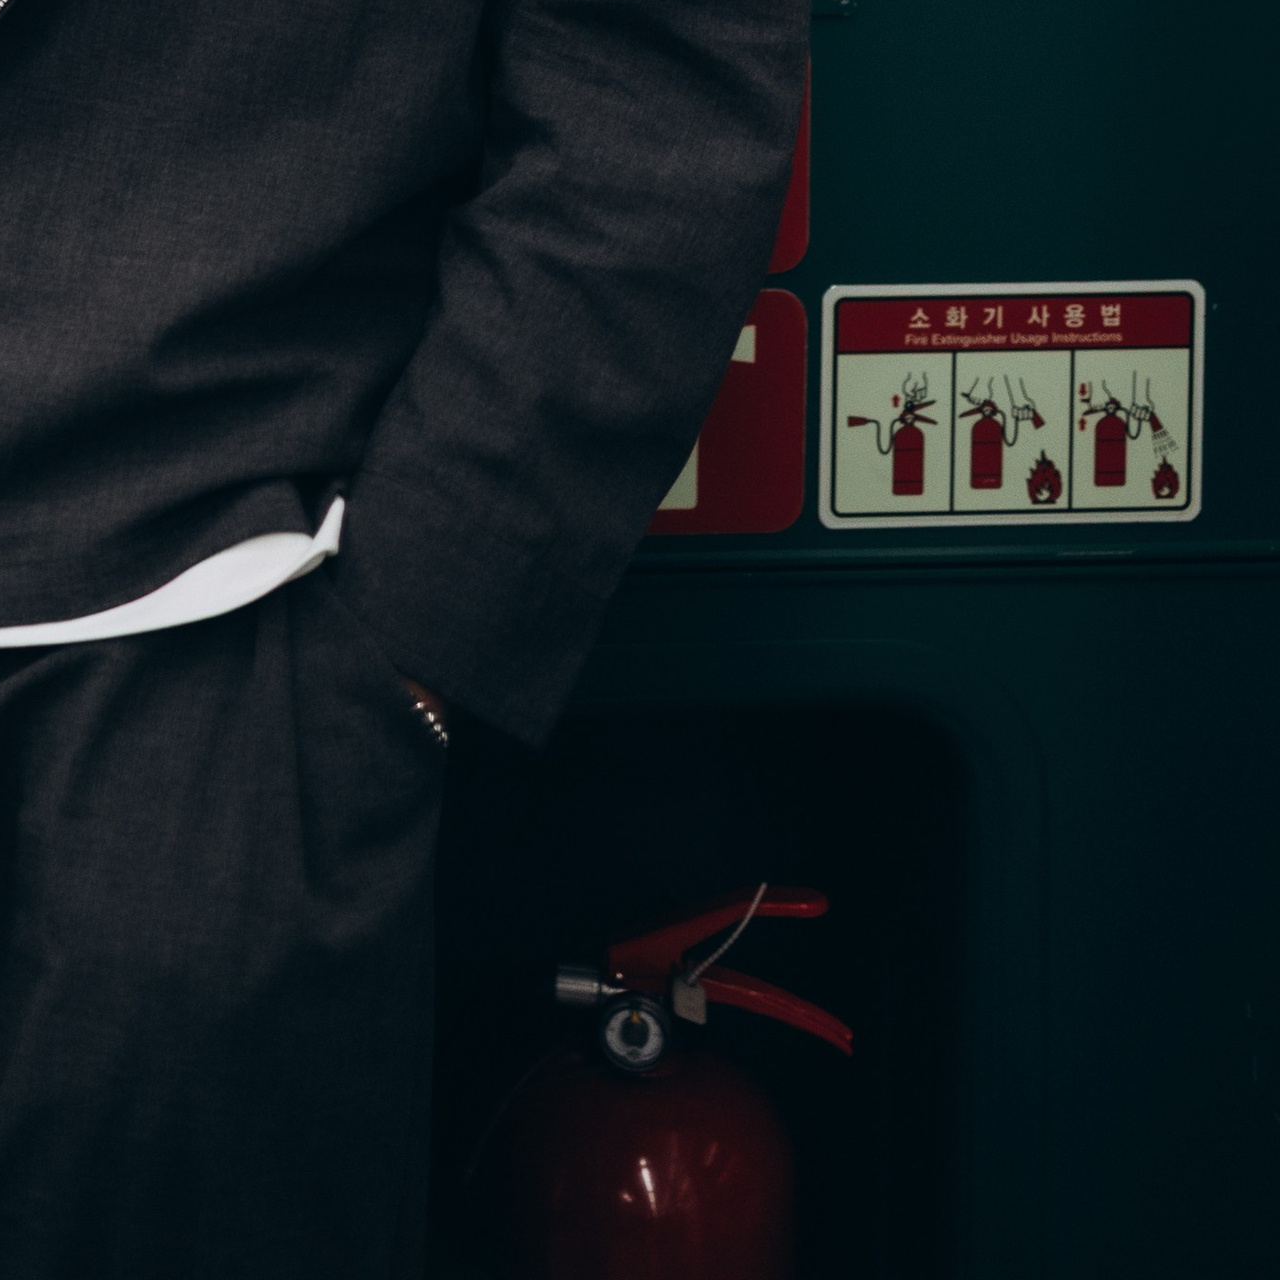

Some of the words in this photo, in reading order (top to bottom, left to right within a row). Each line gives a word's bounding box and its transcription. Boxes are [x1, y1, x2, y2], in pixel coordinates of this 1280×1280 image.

[907, 305, 1005, 330] 소화기
[1026, 303, 1122, 329] 사용법
[904, 333, 929, 346] Fire
[931, 333, 1008, 348] Extinguisher
[1010, 333, 1049, 347] Usage
[1051, 331, 1123, 344] Instructions
